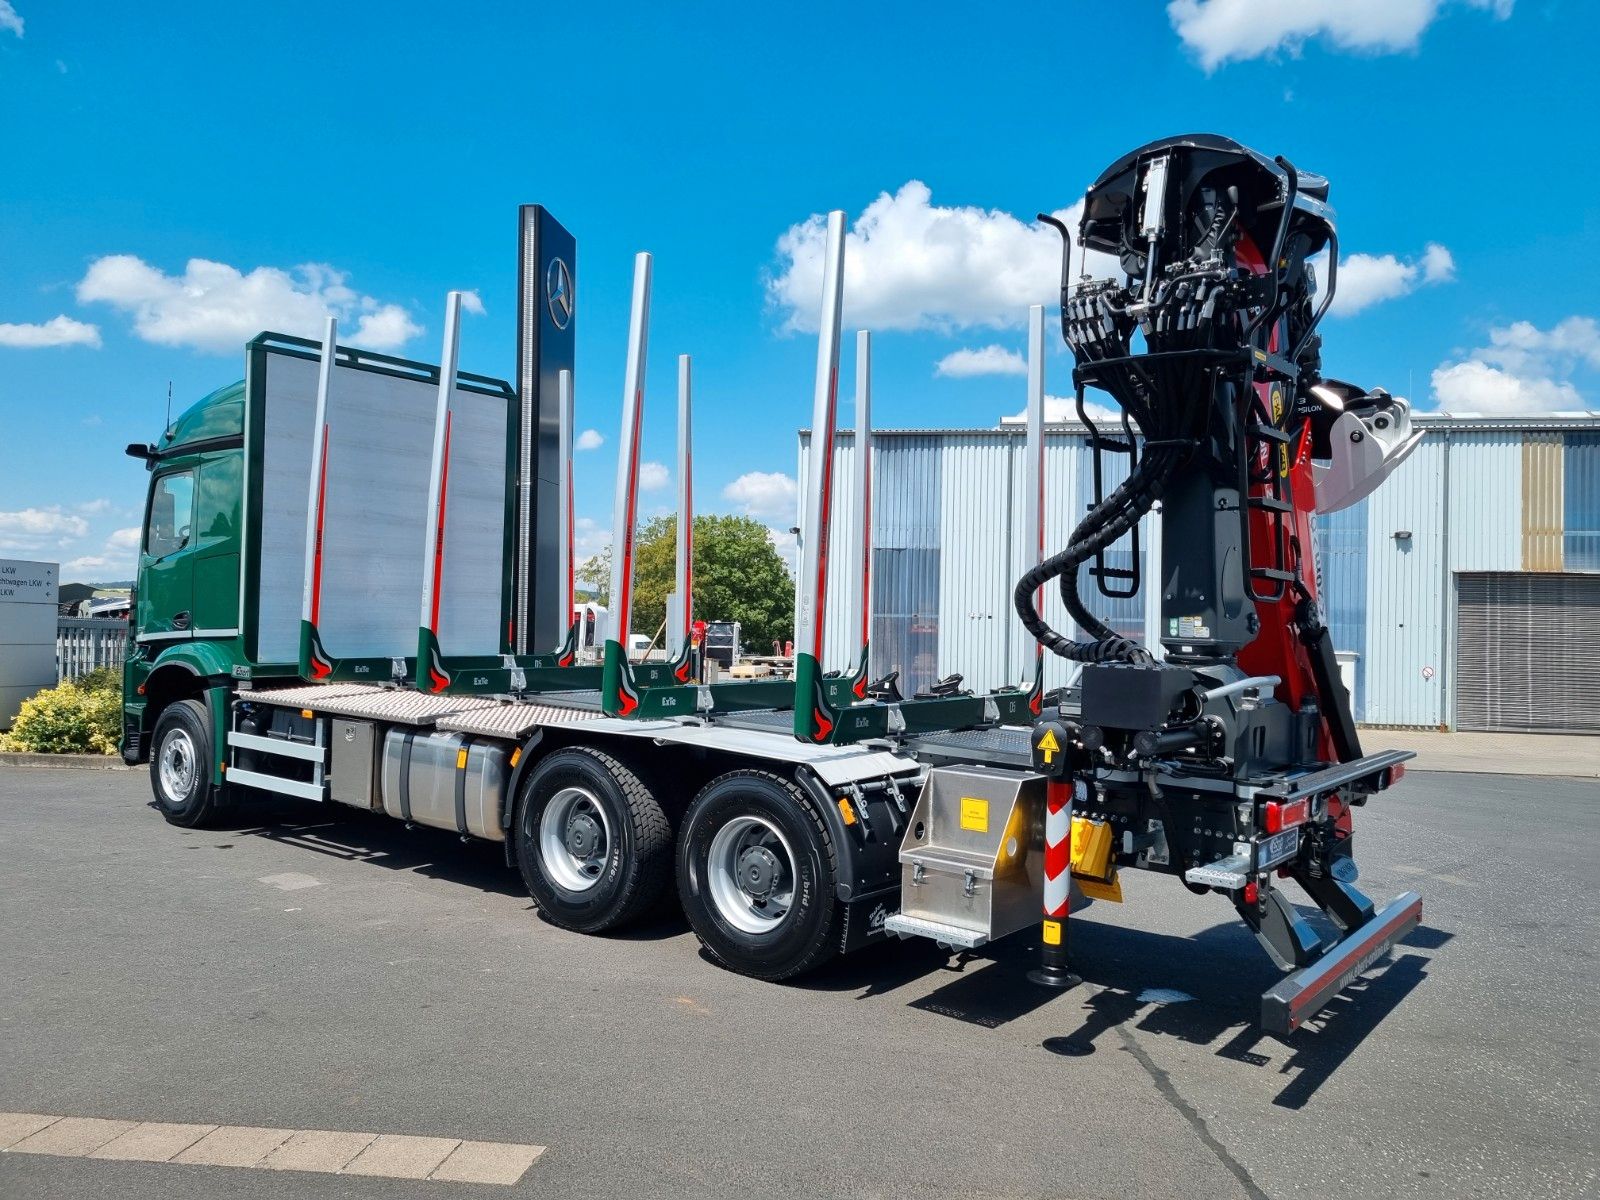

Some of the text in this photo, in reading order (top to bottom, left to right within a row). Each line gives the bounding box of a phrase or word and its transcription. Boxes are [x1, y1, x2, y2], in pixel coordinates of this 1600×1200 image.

[355, 665, 369, 673] ExTe
[474, 677, 489, 685] ExTe
[662, 696, 676, 706] ExTe
